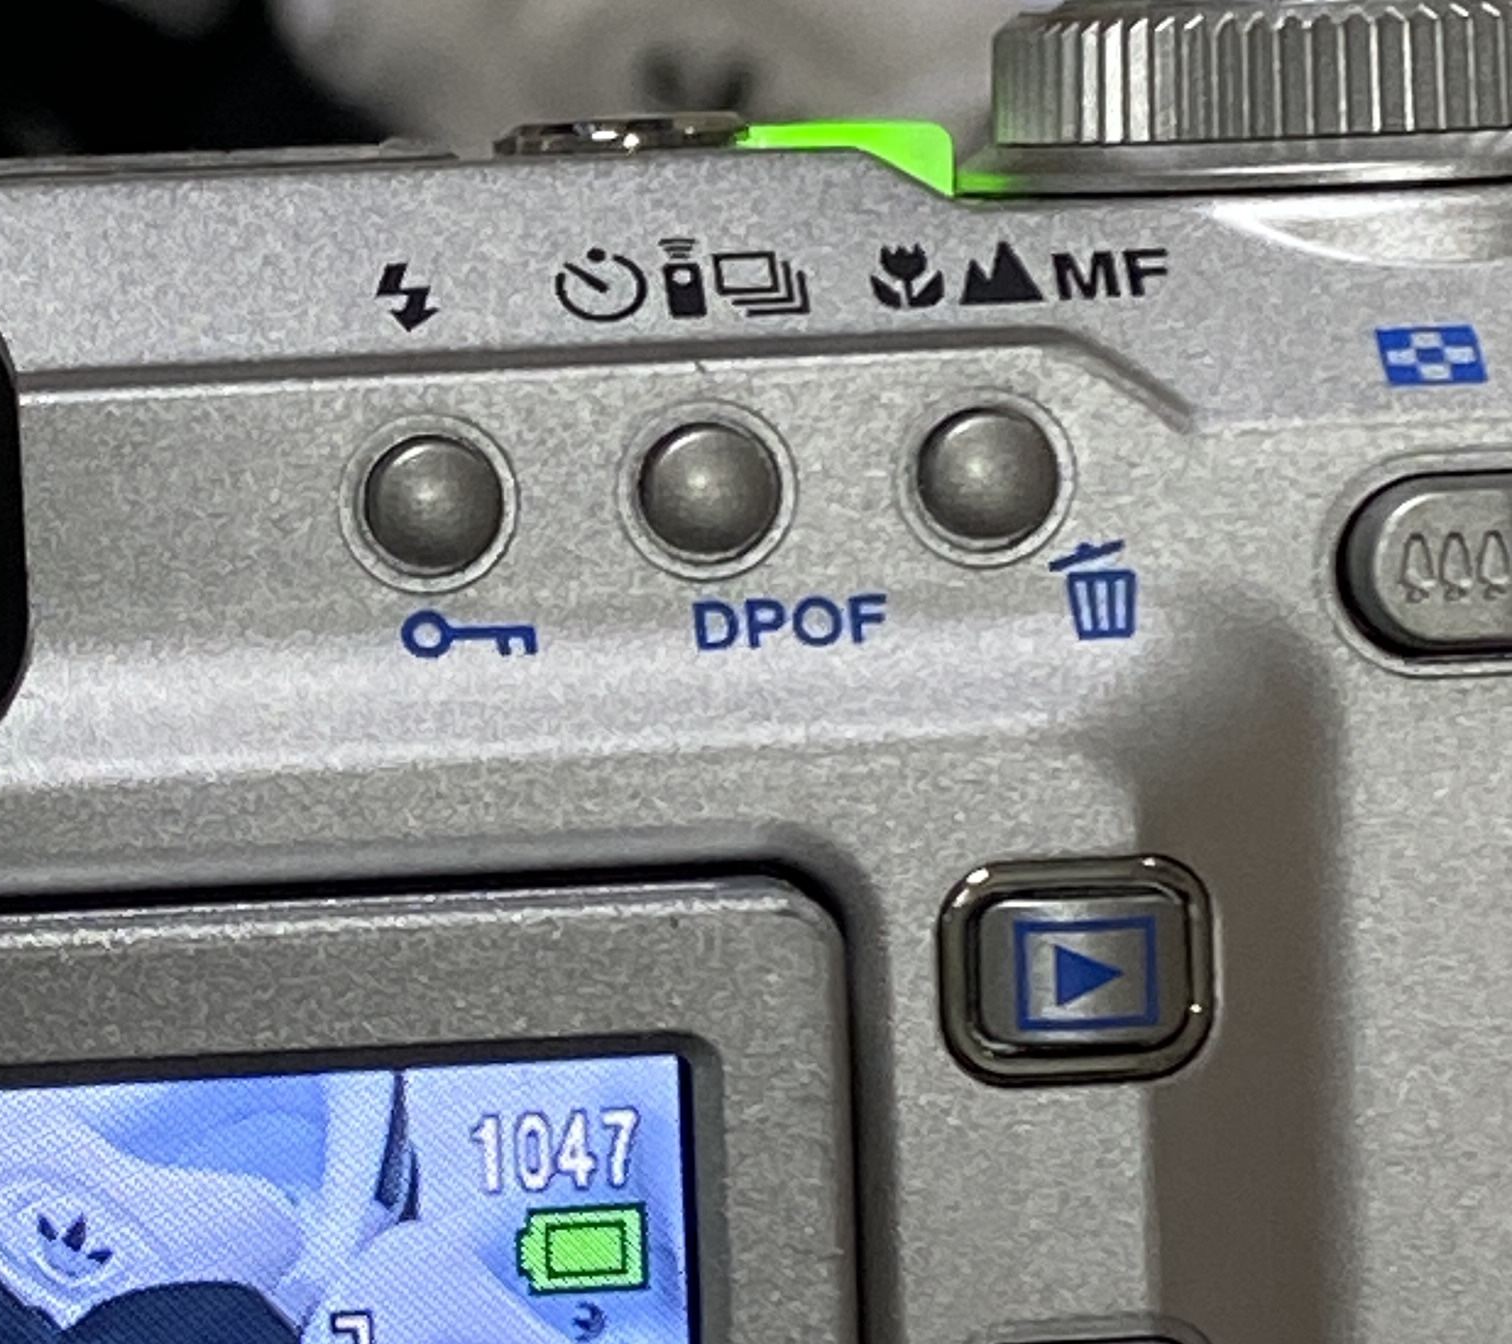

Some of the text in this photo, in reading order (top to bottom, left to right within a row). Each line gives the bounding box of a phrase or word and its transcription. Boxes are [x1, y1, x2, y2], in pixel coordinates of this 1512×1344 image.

[1051, 248, 1168, 300] MF
[692, 593, 887, 650] DPOF
[470, 1107, 639, 1194] 1047
